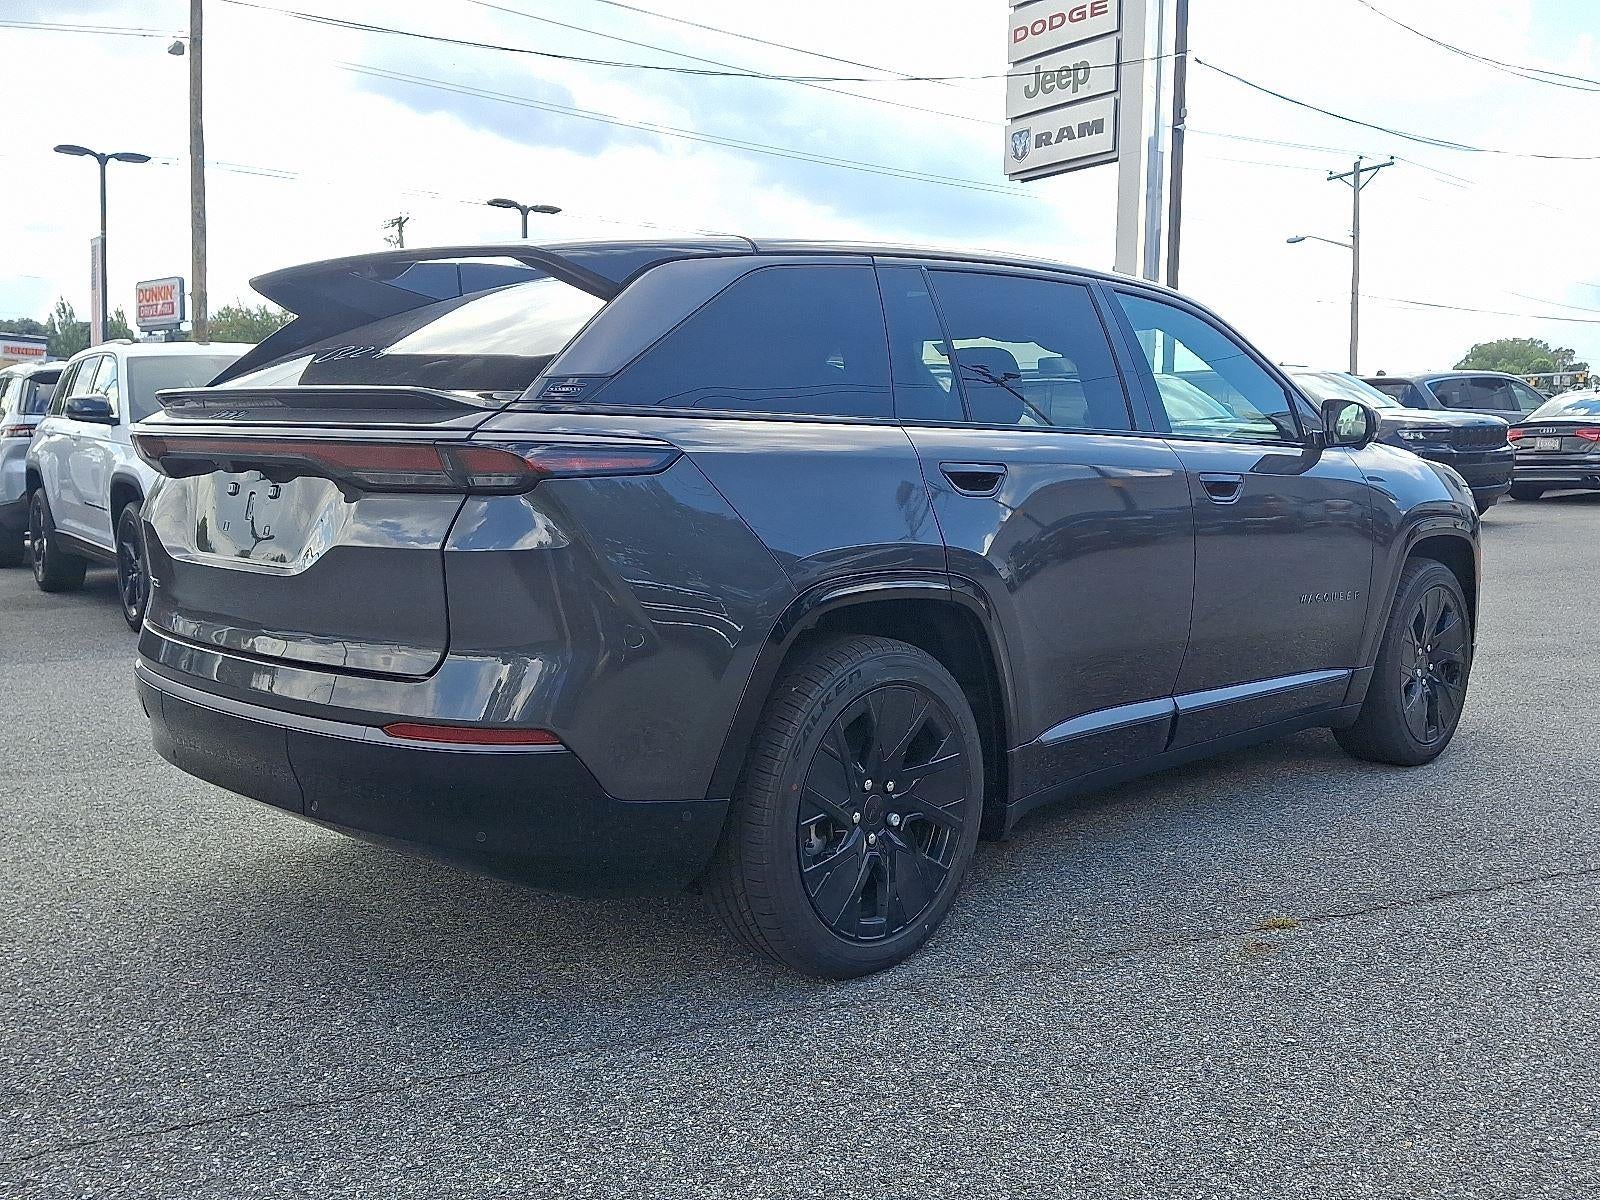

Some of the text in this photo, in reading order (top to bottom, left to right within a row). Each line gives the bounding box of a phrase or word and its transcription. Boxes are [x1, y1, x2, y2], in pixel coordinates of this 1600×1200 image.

[1013, 0, 1108, 43] DODGE
[1024, 60, 1090, 99] Jeep
[1035, 118, 1104, 149] RAM
